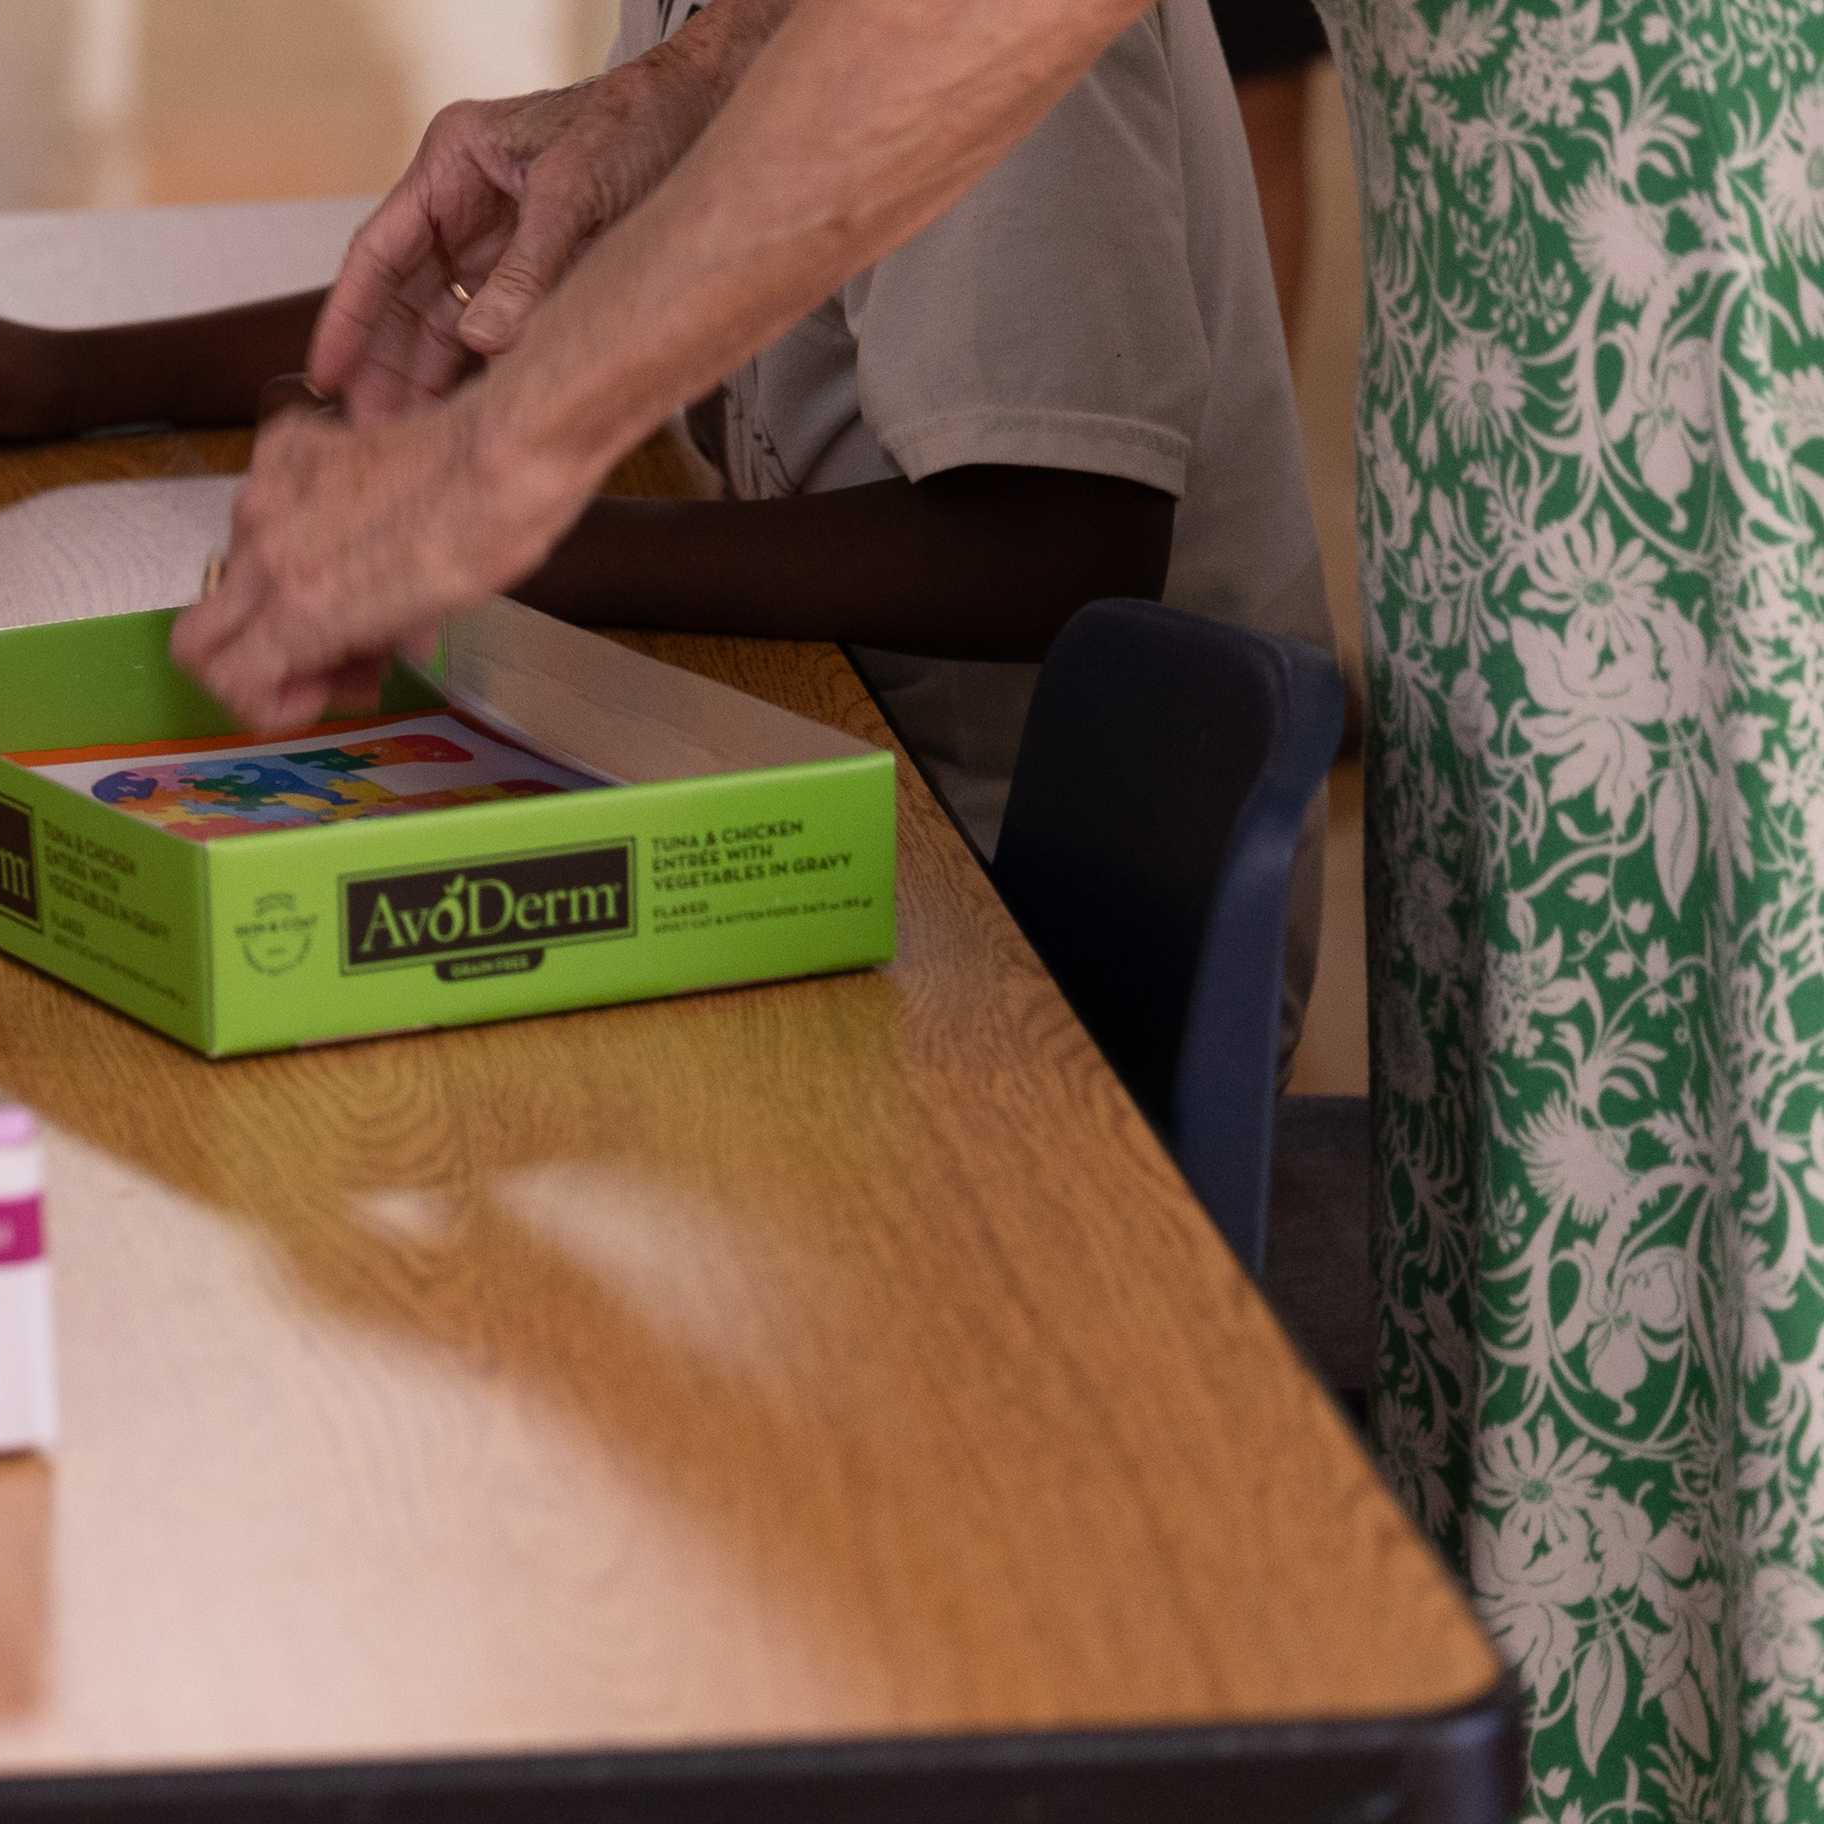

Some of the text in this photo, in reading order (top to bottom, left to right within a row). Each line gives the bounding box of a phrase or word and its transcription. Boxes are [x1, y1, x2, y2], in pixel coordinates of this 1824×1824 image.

[654, 820, 802, 851] TUNA & CHICKEN
[726, 844, 773, 861] WITH
[654, 853, 851, 890] VEGETABLES IN GRAVY
[359, 874, 619, 953] AvoDerm
